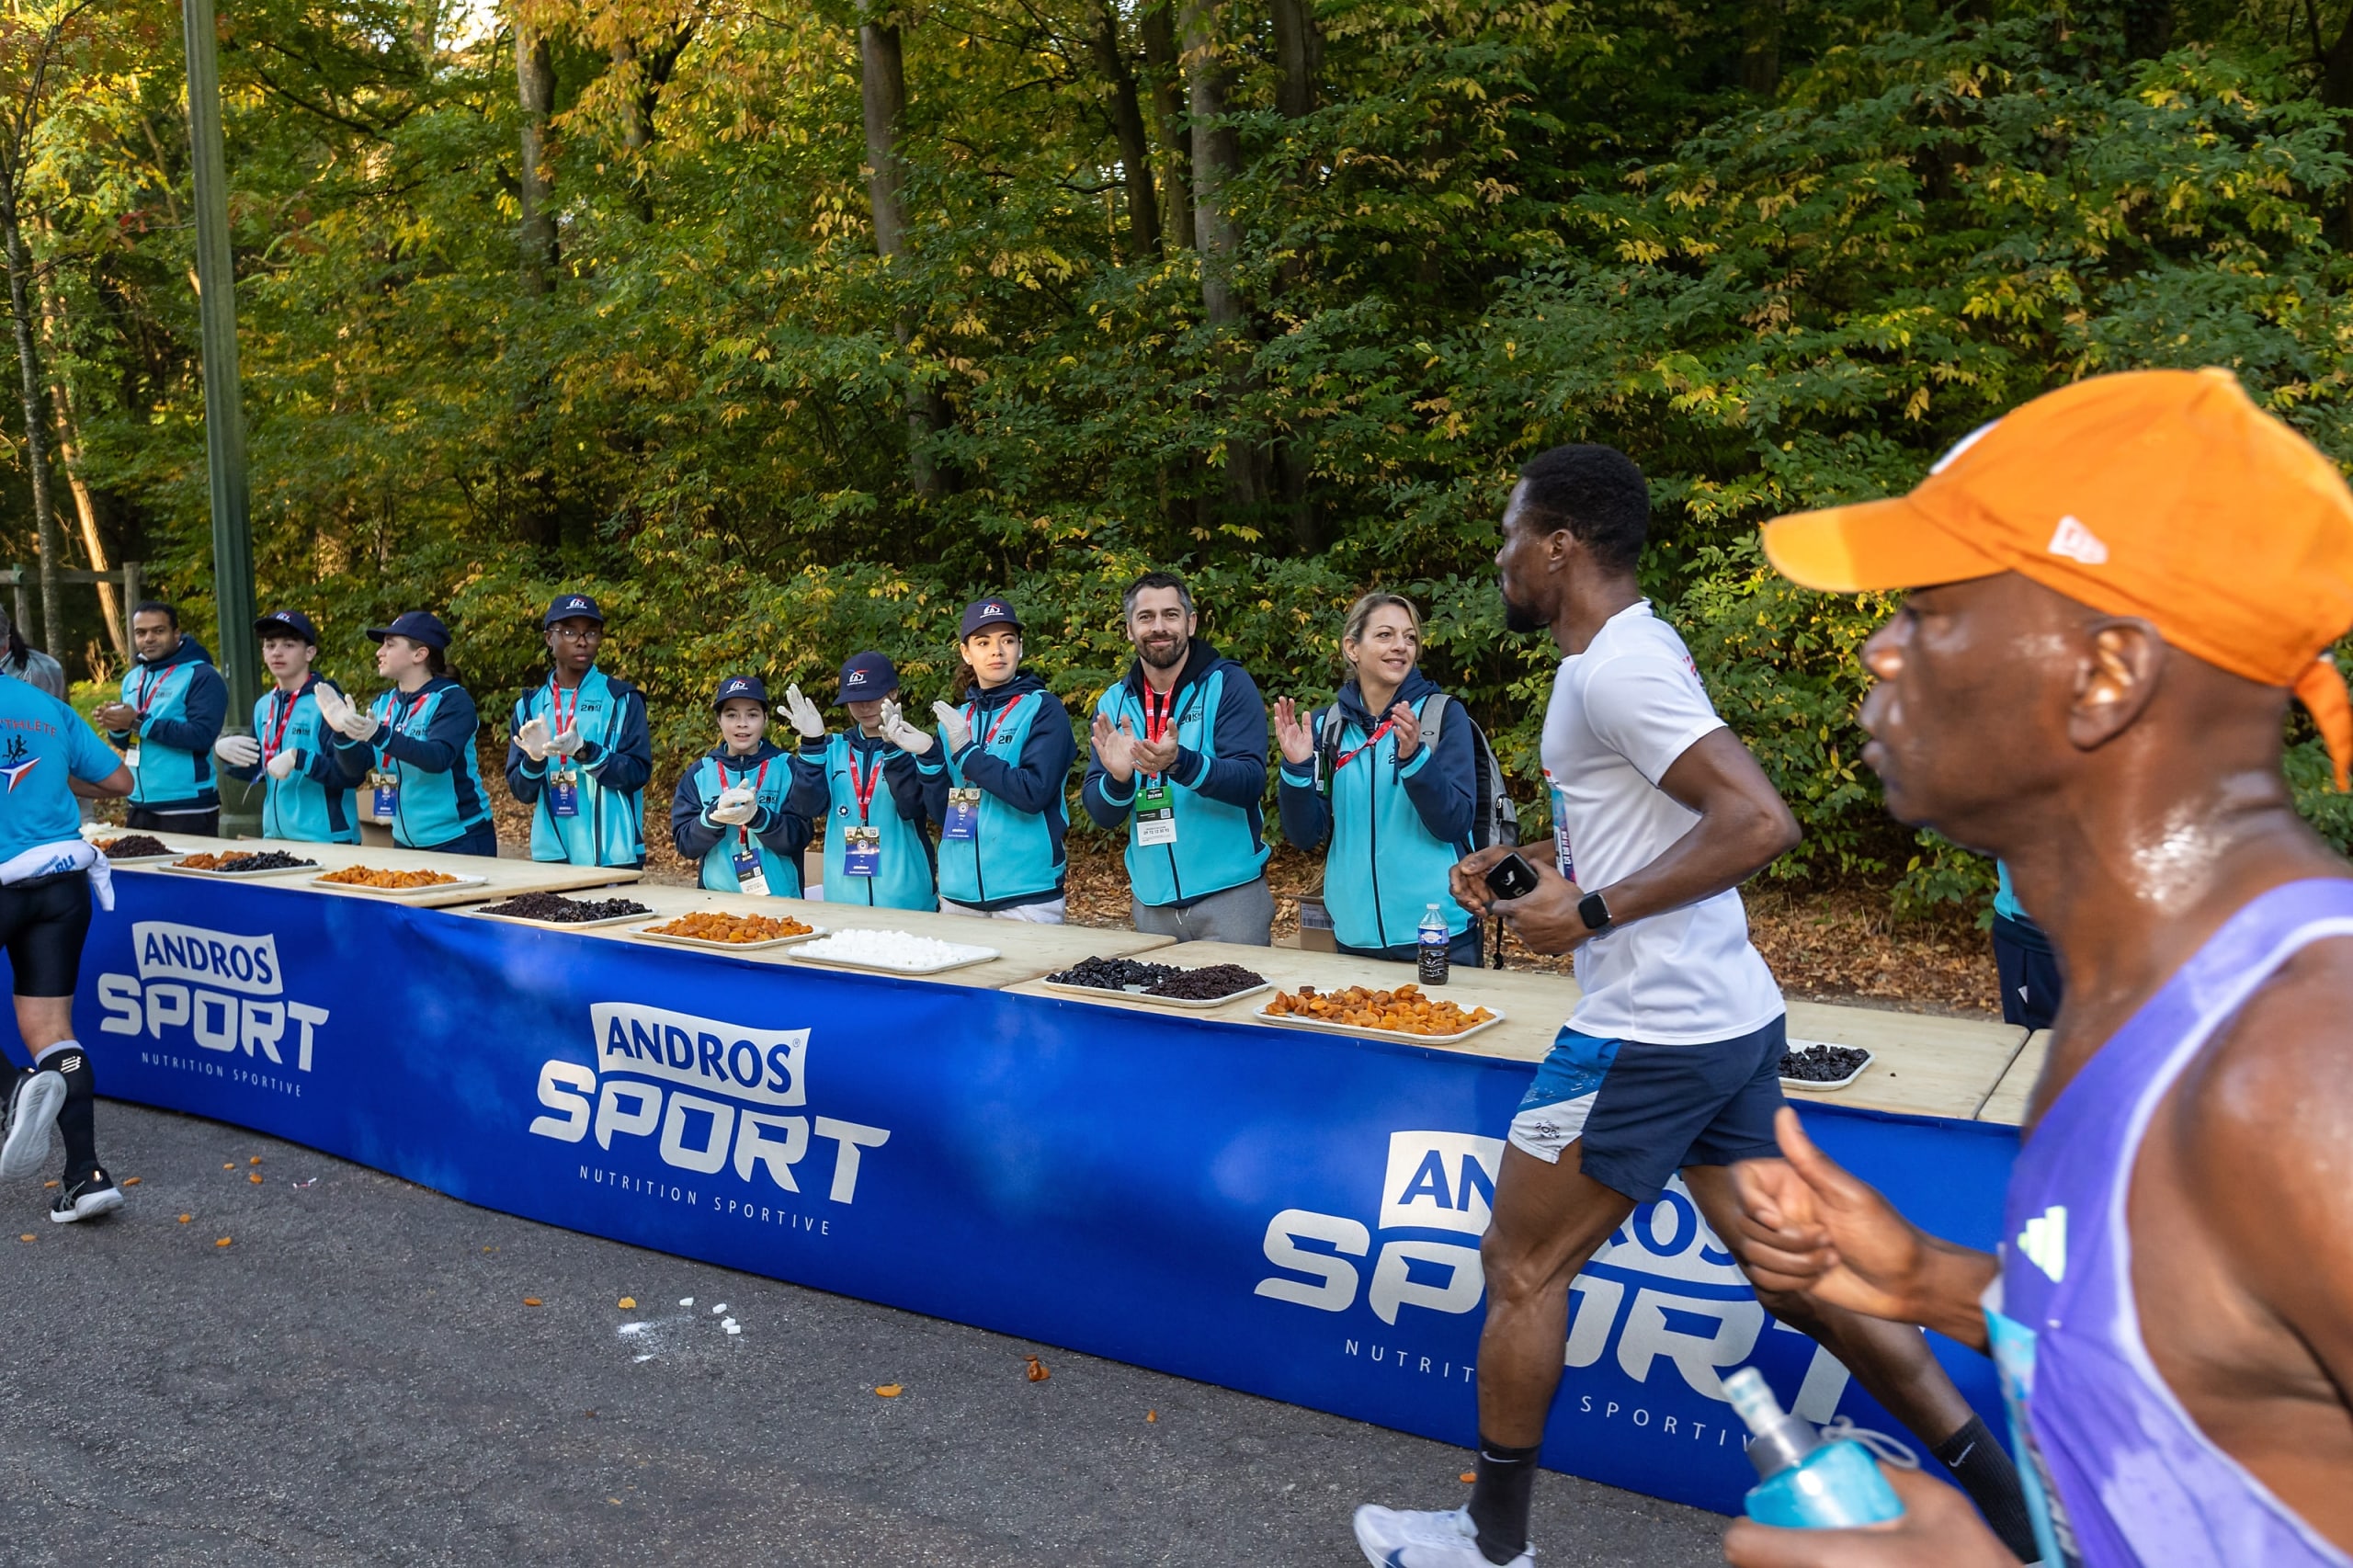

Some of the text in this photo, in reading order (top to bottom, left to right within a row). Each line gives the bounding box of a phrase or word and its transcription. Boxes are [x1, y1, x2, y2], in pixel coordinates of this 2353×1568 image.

[144, 932, 273, 984] ANDROS
[97, 972, 330, 1073] SPORT
[606, 1016, 792, 1094] ANDROS
[142, 1051, 301, 1097] NUTRITION SPORTIVE
[529, 1059, 891, 1204] SPORT
[579, 1165, 830, 1236] NUTRITION SPORTIVE
[1345, 1338, 1756, 1452] NUTRIT SPORTIV
